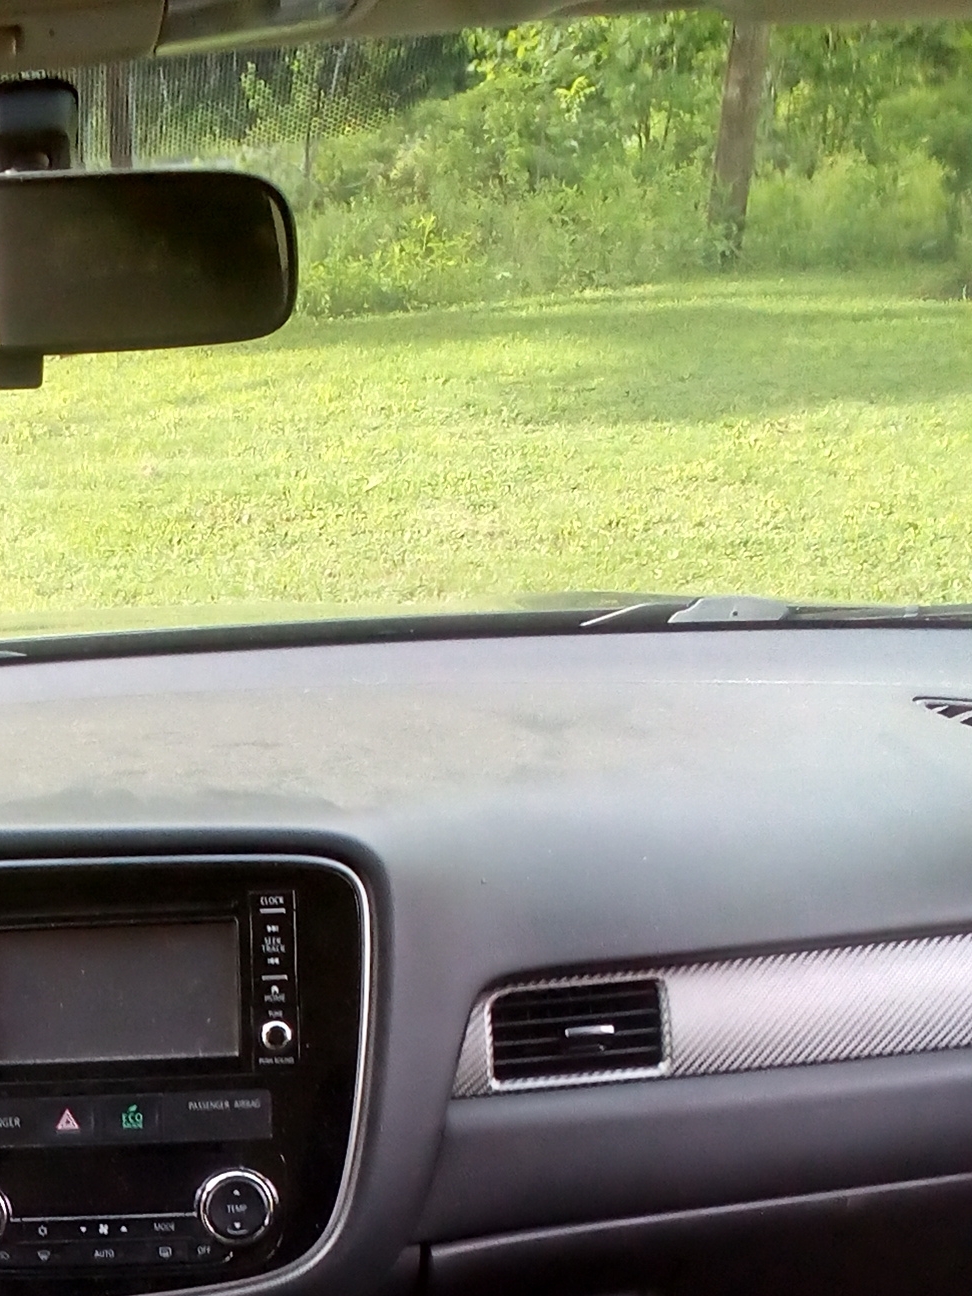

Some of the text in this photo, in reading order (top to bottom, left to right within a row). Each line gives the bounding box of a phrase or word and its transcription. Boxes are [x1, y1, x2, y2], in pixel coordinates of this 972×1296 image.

[260, 896, 284, 905] CLOCK
[188, 1100, 229, 1111] PASSENGER
[121, 1112, 143, 1122] ECO
[227, 1204, 247, 1214] TEMP
[94, 1248, 115, 1259] AUTO
[197, 1245, 211, 1255] OFF
